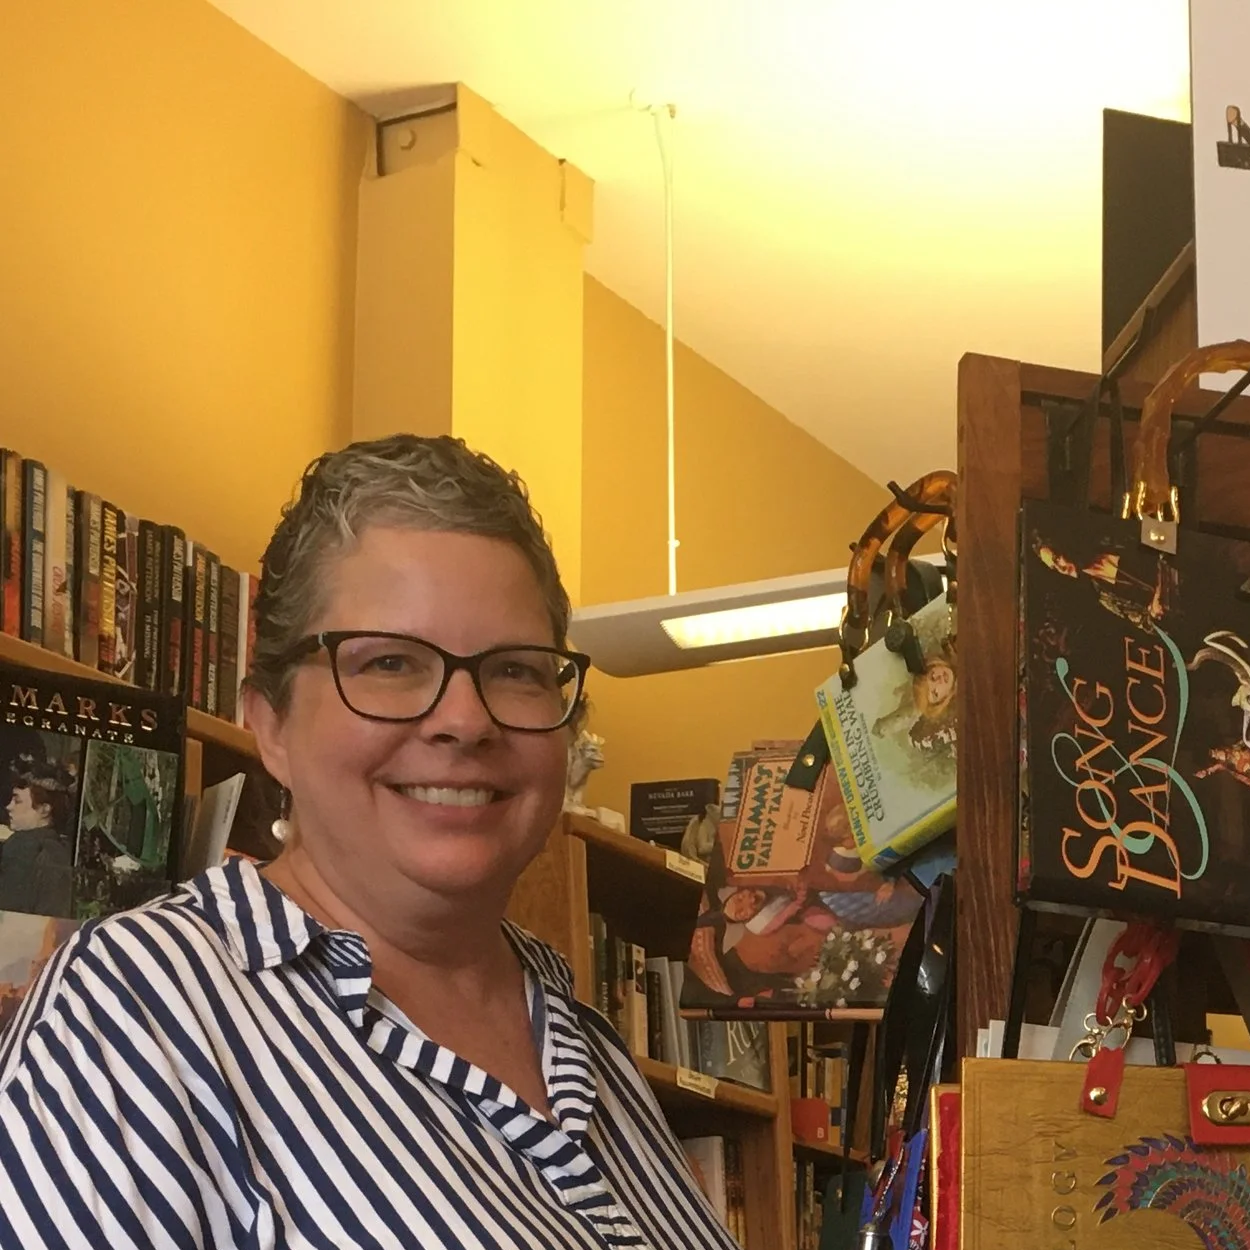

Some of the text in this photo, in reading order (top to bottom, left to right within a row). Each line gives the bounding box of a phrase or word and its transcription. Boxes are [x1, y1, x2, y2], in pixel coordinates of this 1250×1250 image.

[102, 508, 116, 554] JAMES
[9, 684, 158, 731] MARKS
[833, 692, 877, 823] THE CLUE IN THE
[837, 765, 856, 800] DREW
[852, 726, 886, 821] CRUMBLING
[1061, 676, 1130, 889] SONG
[1115, 635, 1182, 899] DANCE
[736, 763, 774, 869] GRIMM'S
[756, 764, 788, 866] FAIRY TALES
[849, 804, 867, 846] NANCY
